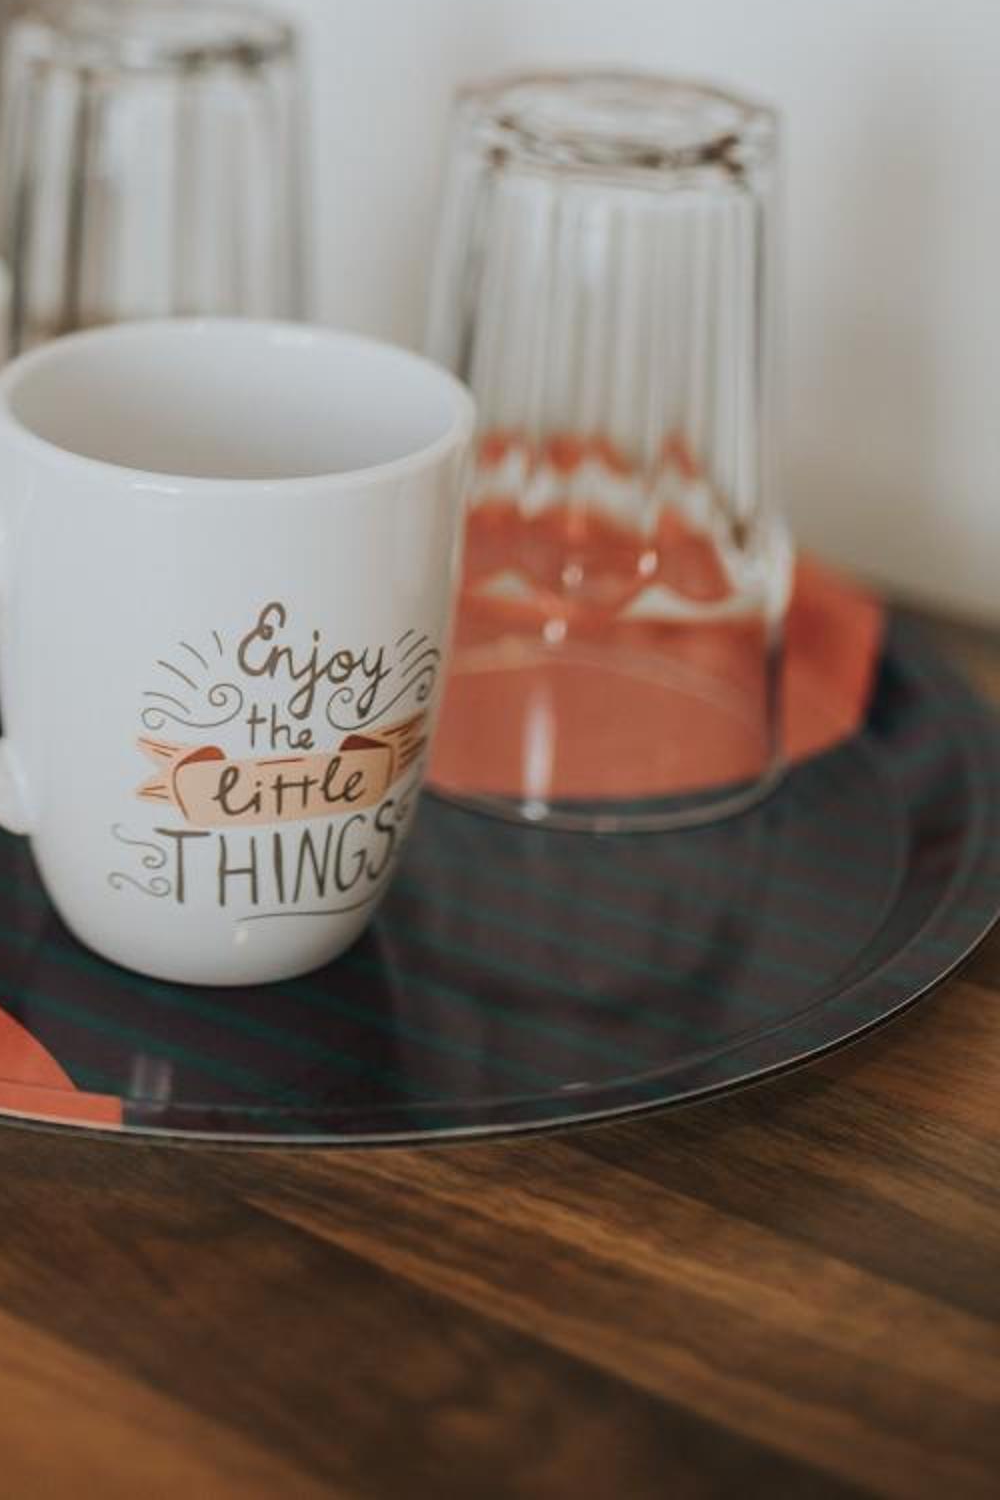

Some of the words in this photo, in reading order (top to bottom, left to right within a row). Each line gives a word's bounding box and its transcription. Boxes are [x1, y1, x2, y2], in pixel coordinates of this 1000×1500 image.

[238, 601, 392, 719] Enjoy
[246, 703, 314, 750] the
[212, 756, 366, 816] little
[155, 798, 396, 907] THINGS
